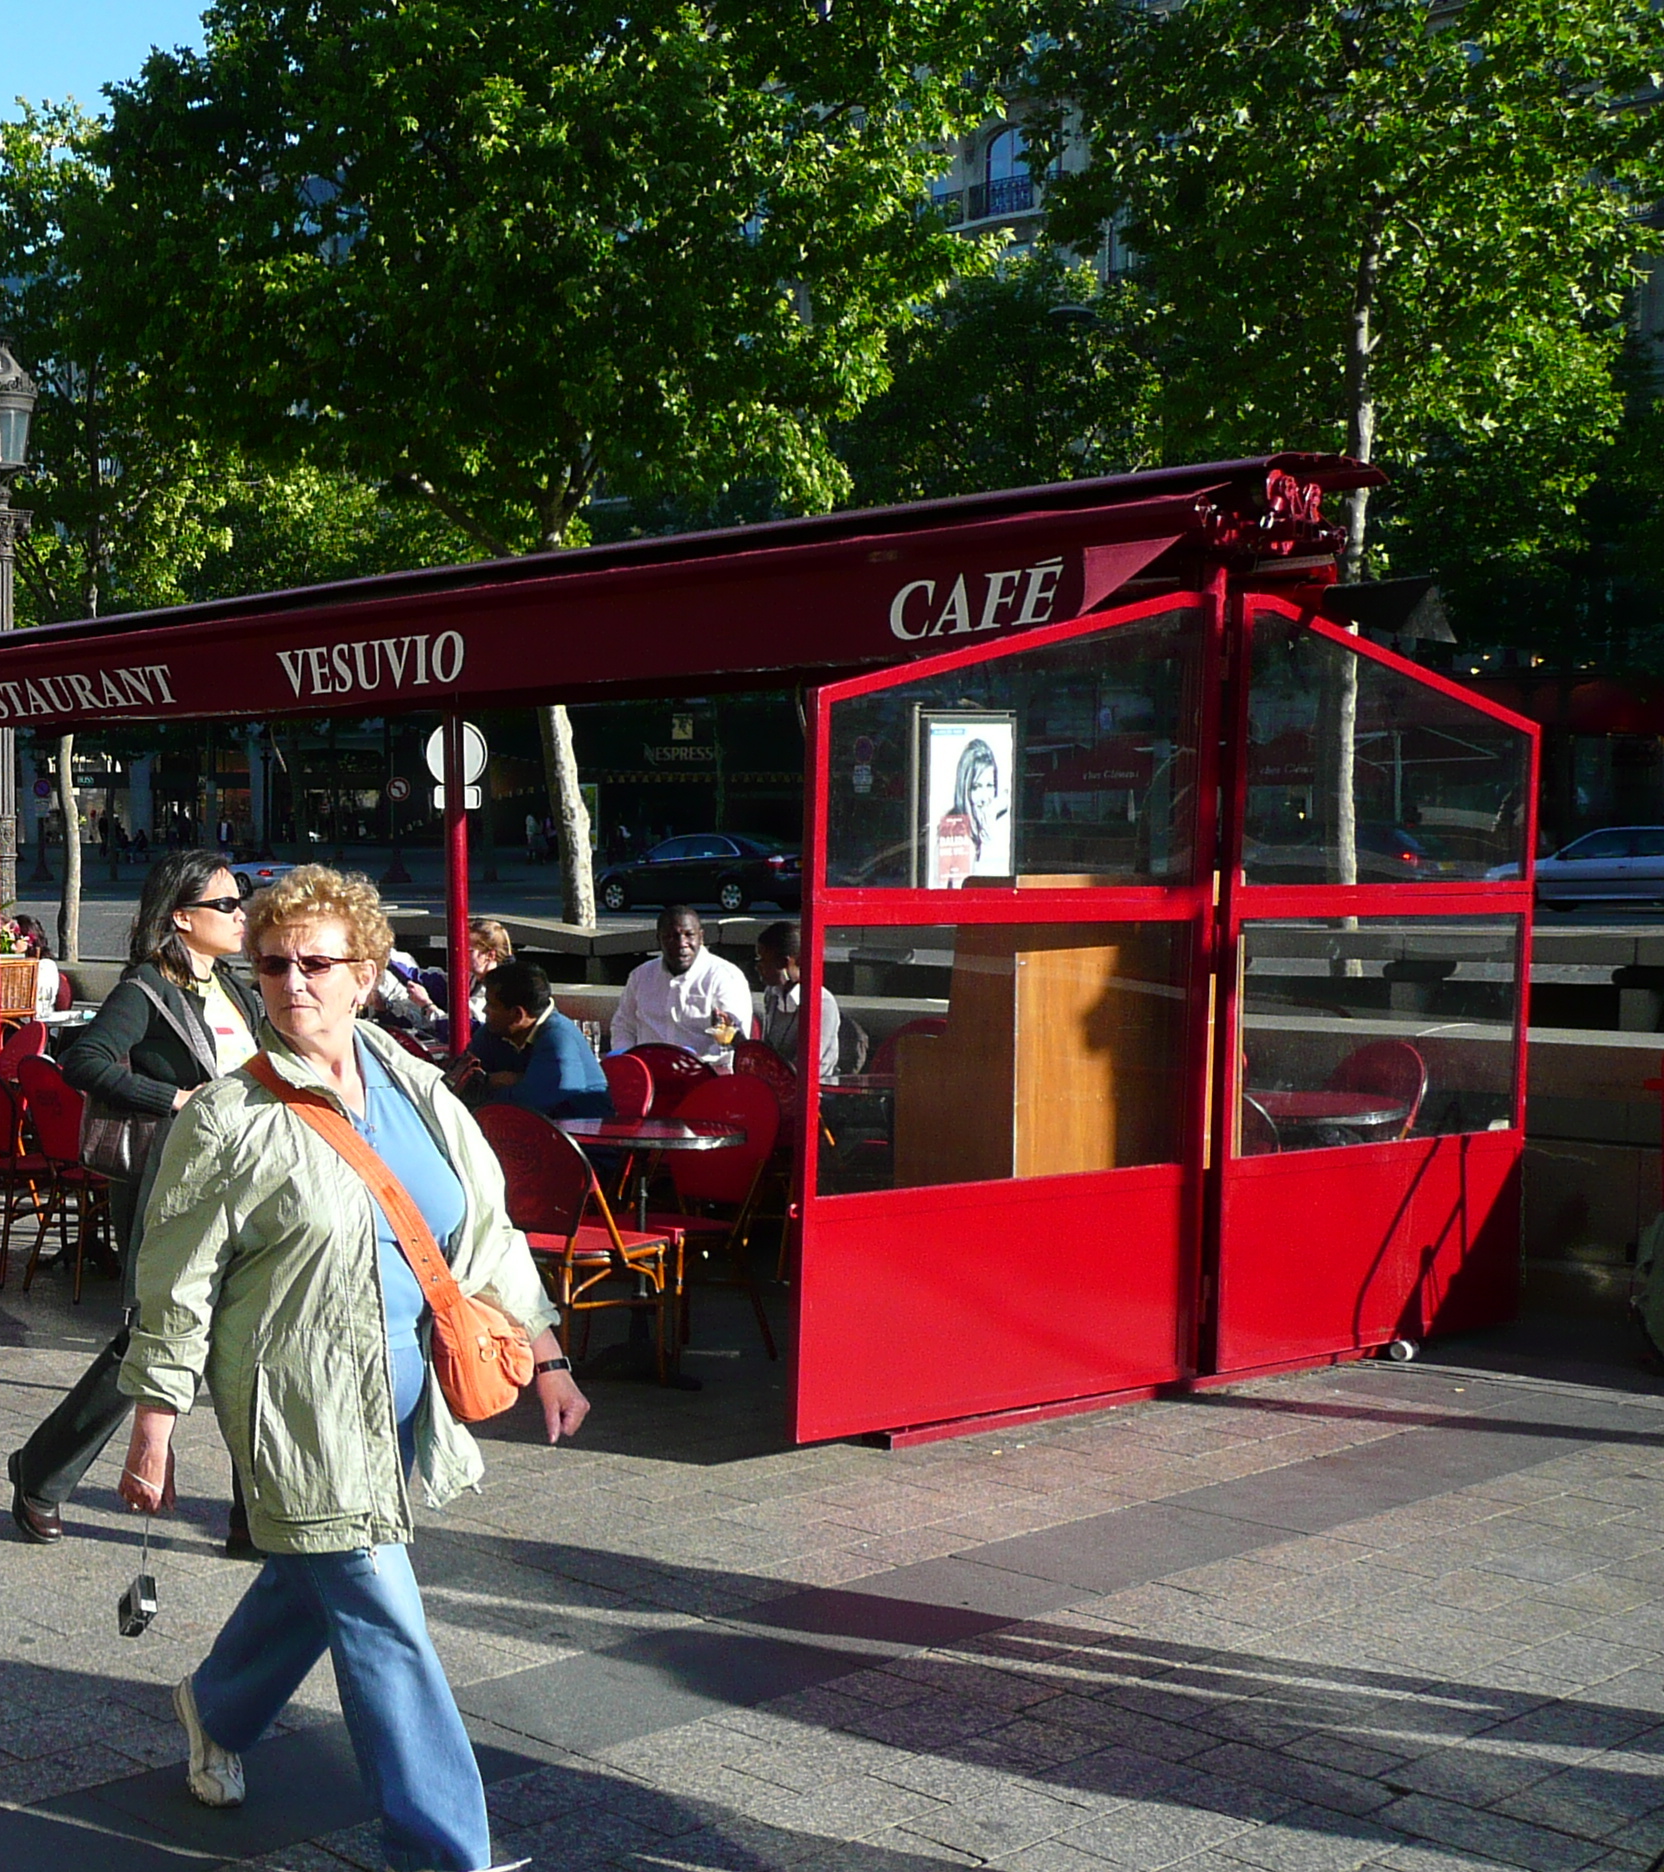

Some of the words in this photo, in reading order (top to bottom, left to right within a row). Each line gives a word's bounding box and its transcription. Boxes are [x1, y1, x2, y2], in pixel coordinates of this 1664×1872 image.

[276, 630, 464, 699] VESUVIO
[889, 556, 1064, 641] CAFÉ
[641, 742, 723, 766] NESPRESS
